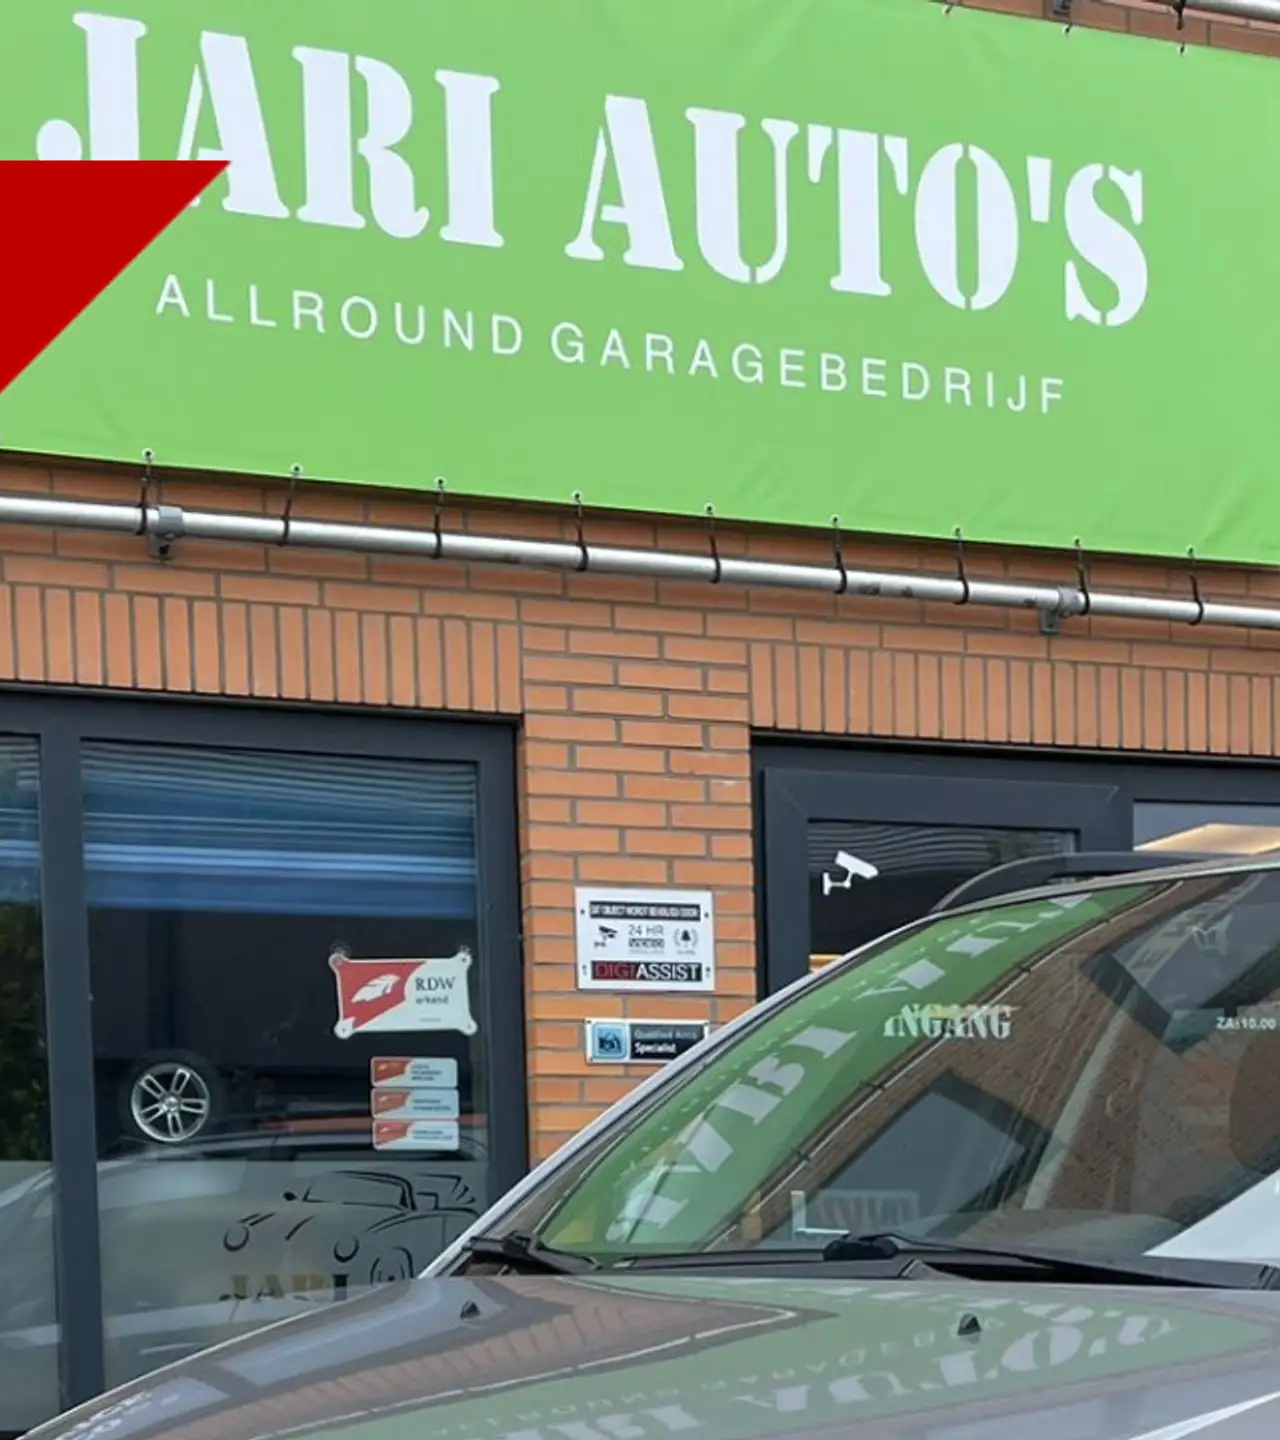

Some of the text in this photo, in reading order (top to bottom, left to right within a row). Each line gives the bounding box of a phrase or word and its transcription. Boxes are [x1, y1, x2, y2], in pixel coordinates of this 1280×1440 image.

[36, 12, 1149, 327] JARI AUTO'S
[155, 274, 1065, 414] ALLROUND GARAGEBEDRIJF
[415, 976, 456, 992] RDW
[594, 963, 699, 981] DIGIASSIST
